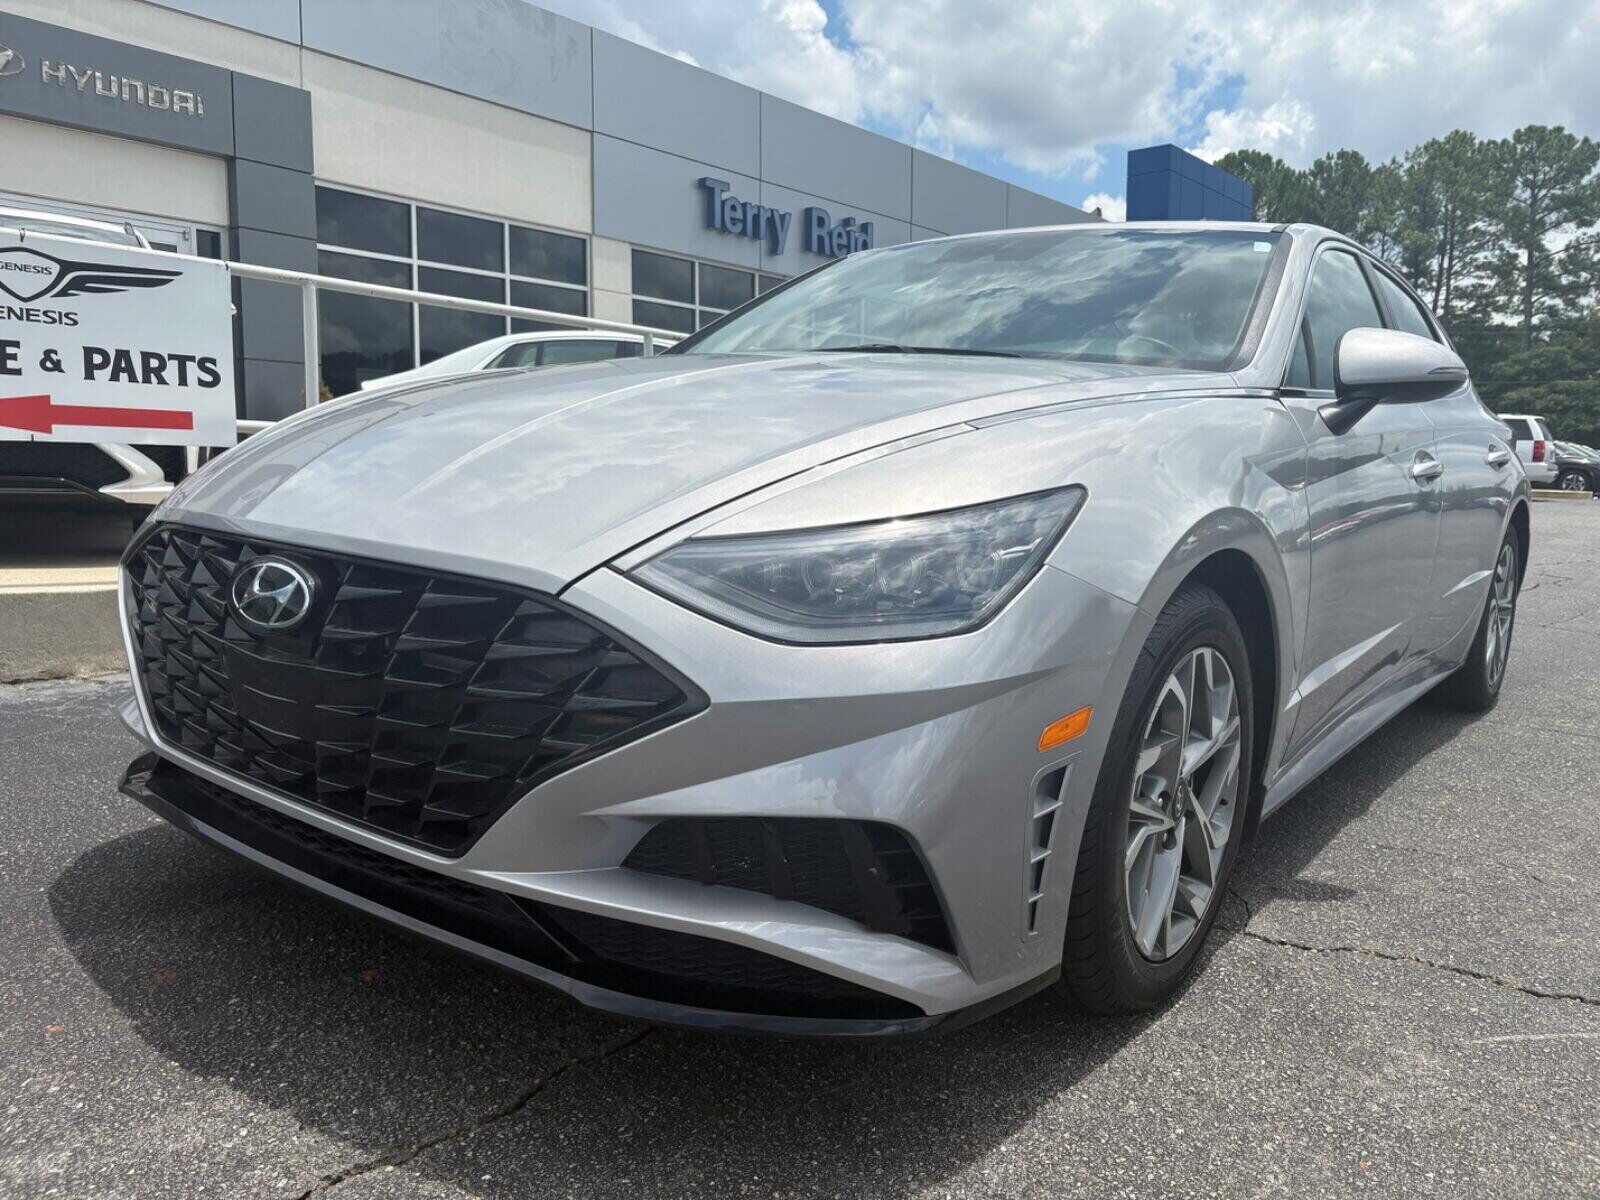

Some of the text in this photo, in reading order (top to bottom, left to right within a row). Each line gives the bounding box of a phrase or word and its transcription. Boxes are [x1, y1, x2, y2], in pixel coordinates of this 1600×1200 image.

[41, 57, 204, 118] HYUNDAI
[698, 176, 874, 257] Terry Reid
[39, 348, 66, 373] &
[82, 345, 222, 388] PARTS
